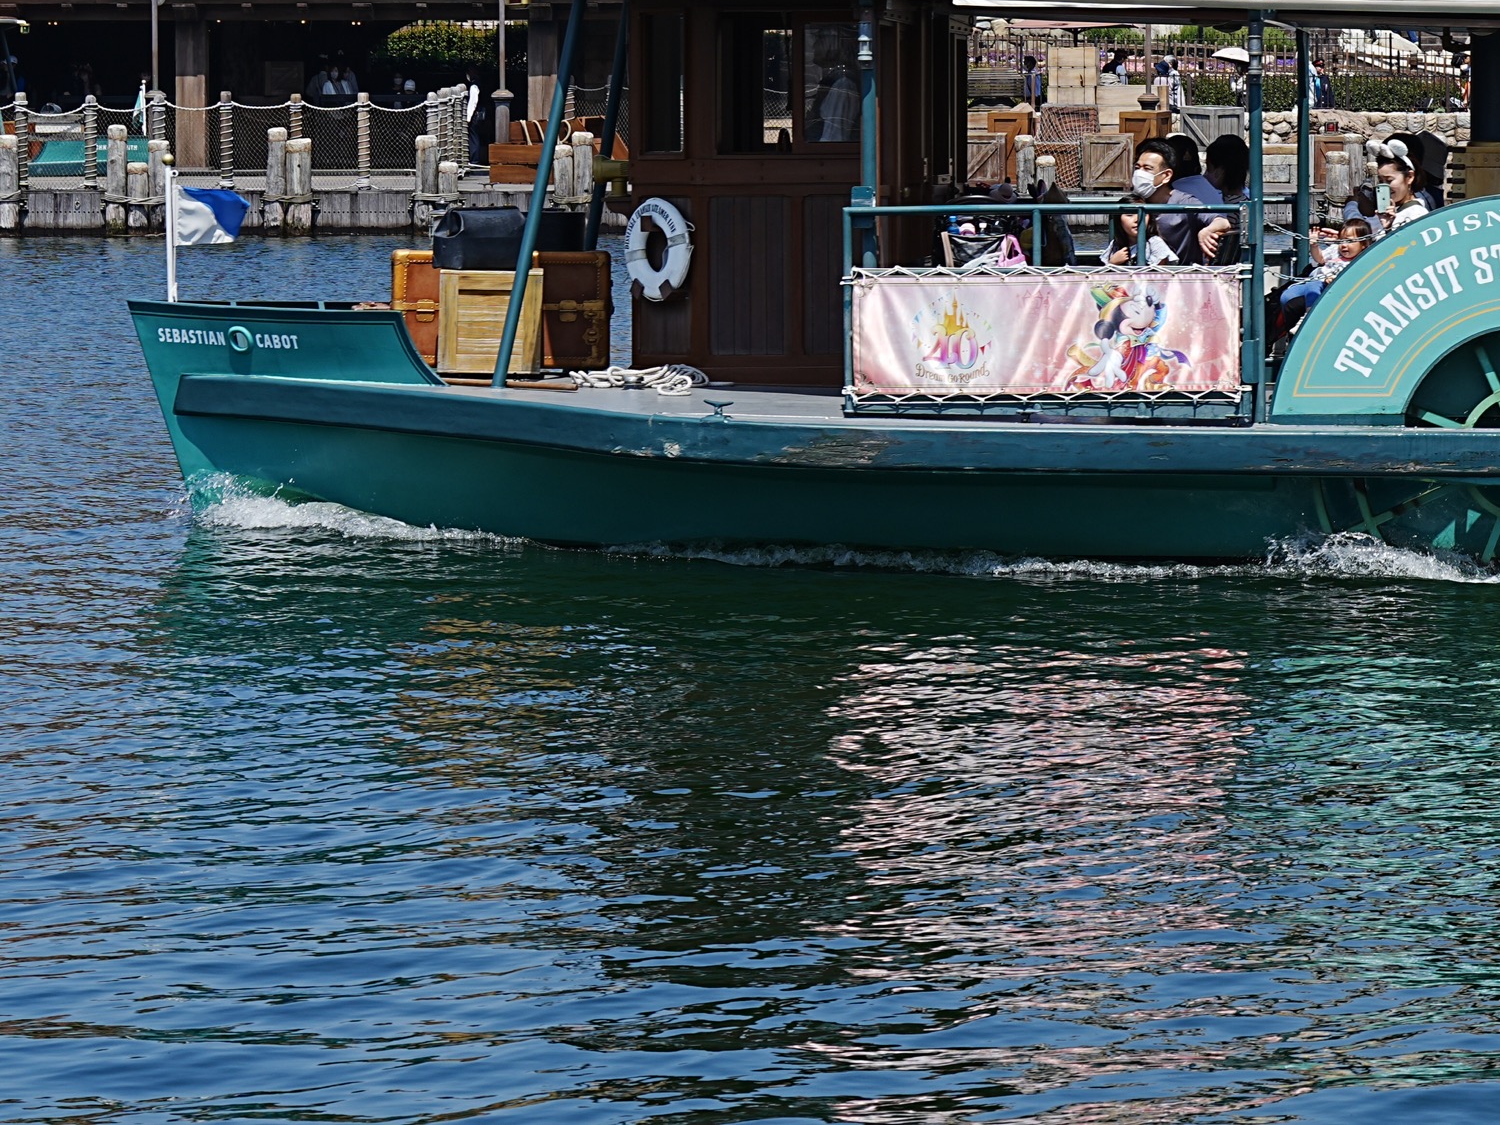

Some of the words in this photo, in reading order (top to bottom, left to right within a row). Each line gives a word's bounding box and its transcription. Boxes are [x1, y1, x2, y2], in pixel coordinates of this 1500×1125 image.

[1334, 255, 1460, 378] TRANSIT
[158, 328, 226, 346] SEBASTIAN
[255, 334, 298, 350] CABOT
[923, 324, 978, 369] 40
[915, 363, 943, 382] Dream
